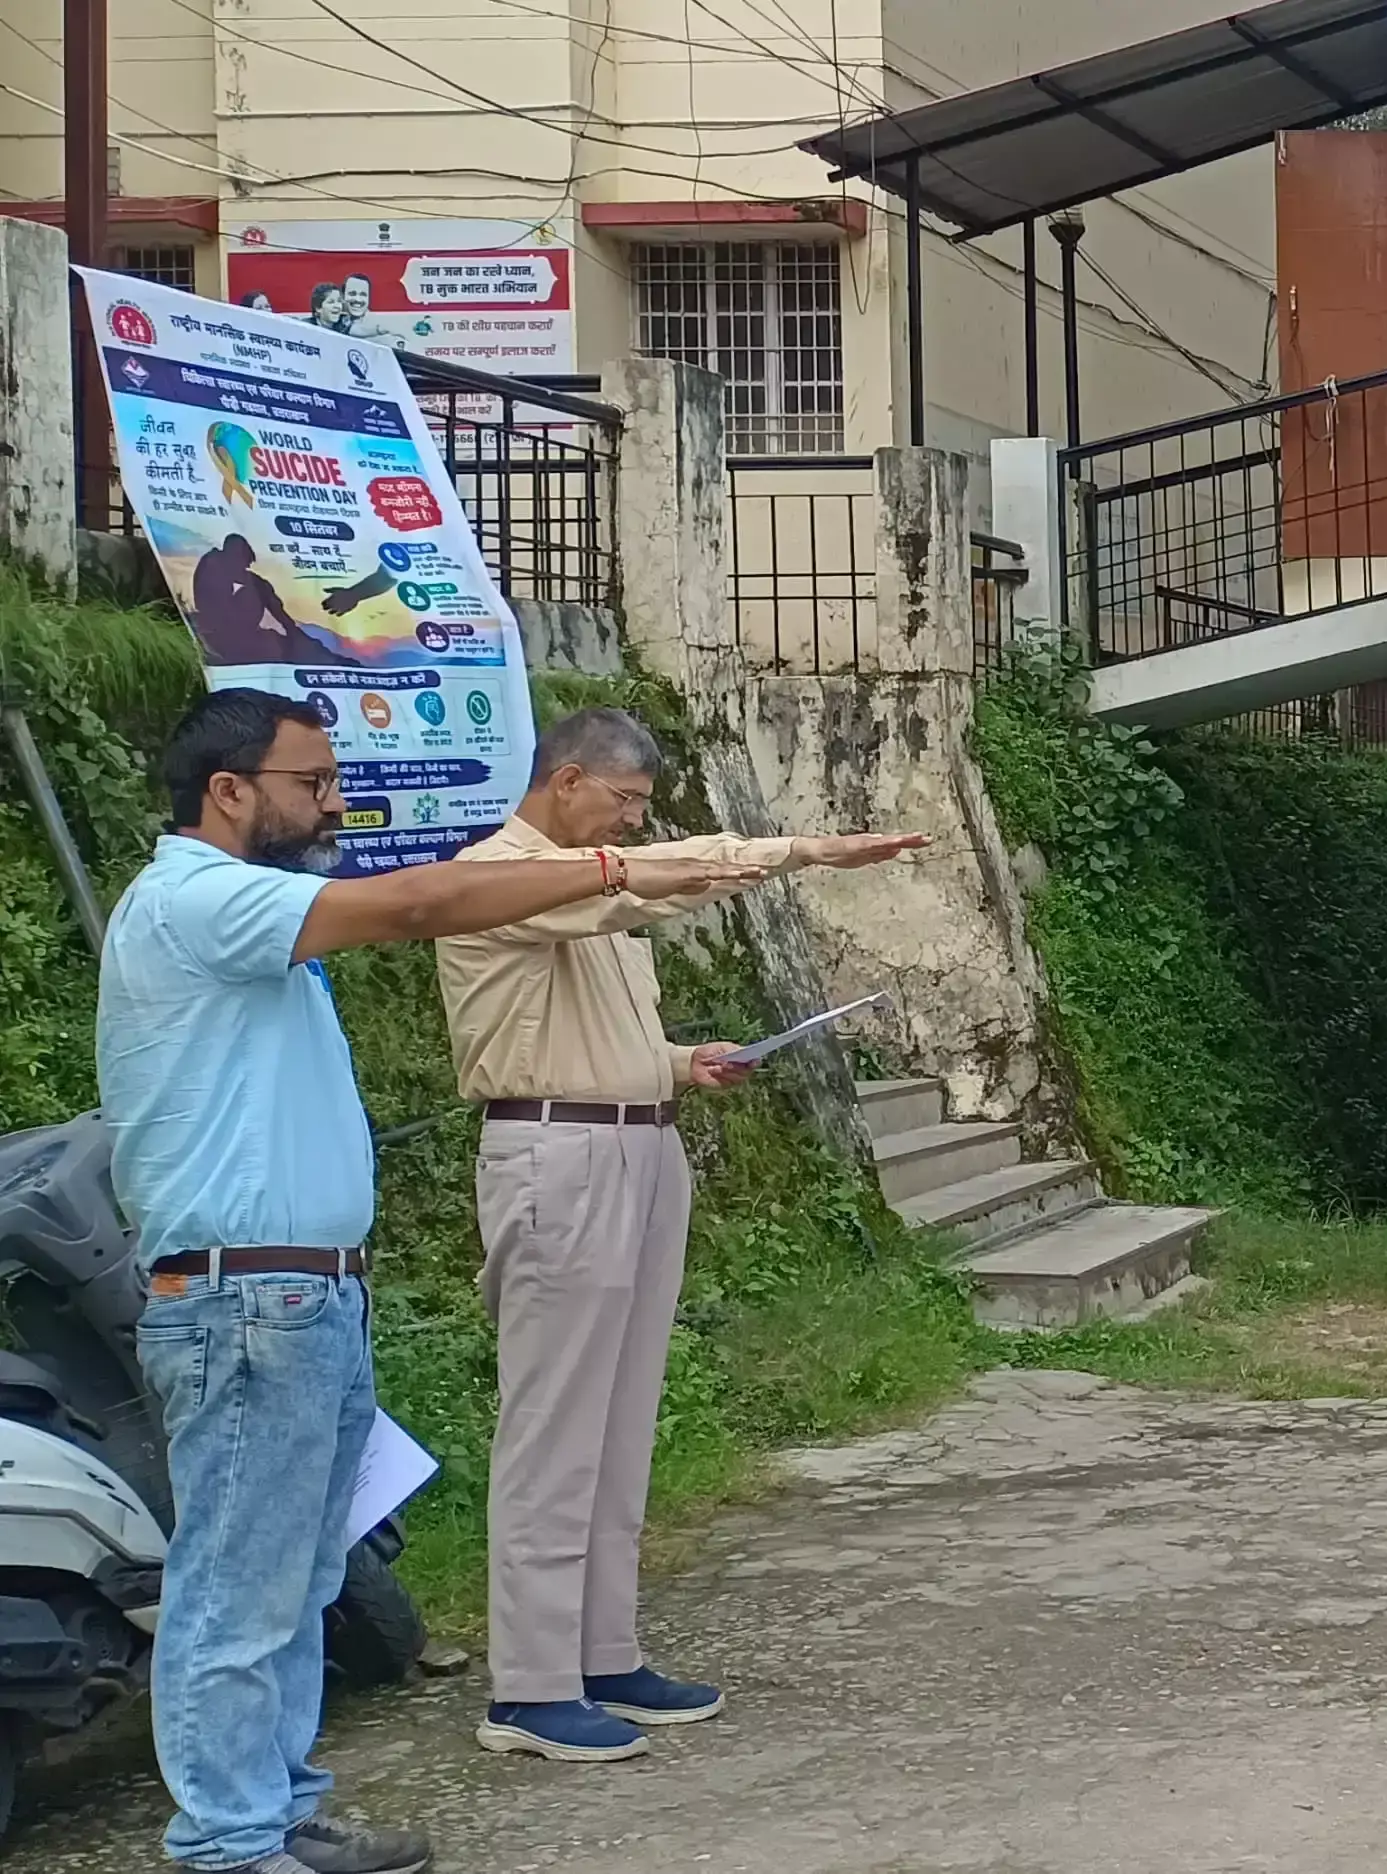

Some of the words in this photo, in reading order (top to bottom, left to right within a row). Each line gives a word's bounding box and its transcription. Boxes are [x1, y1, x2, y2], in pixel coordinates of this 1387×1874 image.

[461, 283, 489, 294] भारत
[493, 280, 537, 294] अभियान
[168, 314, 201, 333] राष्ट्रीय
[203, 322, 246, 342] मानसिक
[138, 414, 176, 436] जीवन
[135, 436, 151, 456] की
[153, 442, 169, 458] हर
[172, 443, 197, 462] सुबह
[258, 429, 313, 452] WORLD
[145, 460, 183, 481] कीमती
[250, 446, 347, 488] SUICIDE
[248, 479, 331, 503] PREVENTION
[331, 488, 359, 506] DAY
[288, 521, 303, 533] 10
[347, 813, 378, 826] 14416
